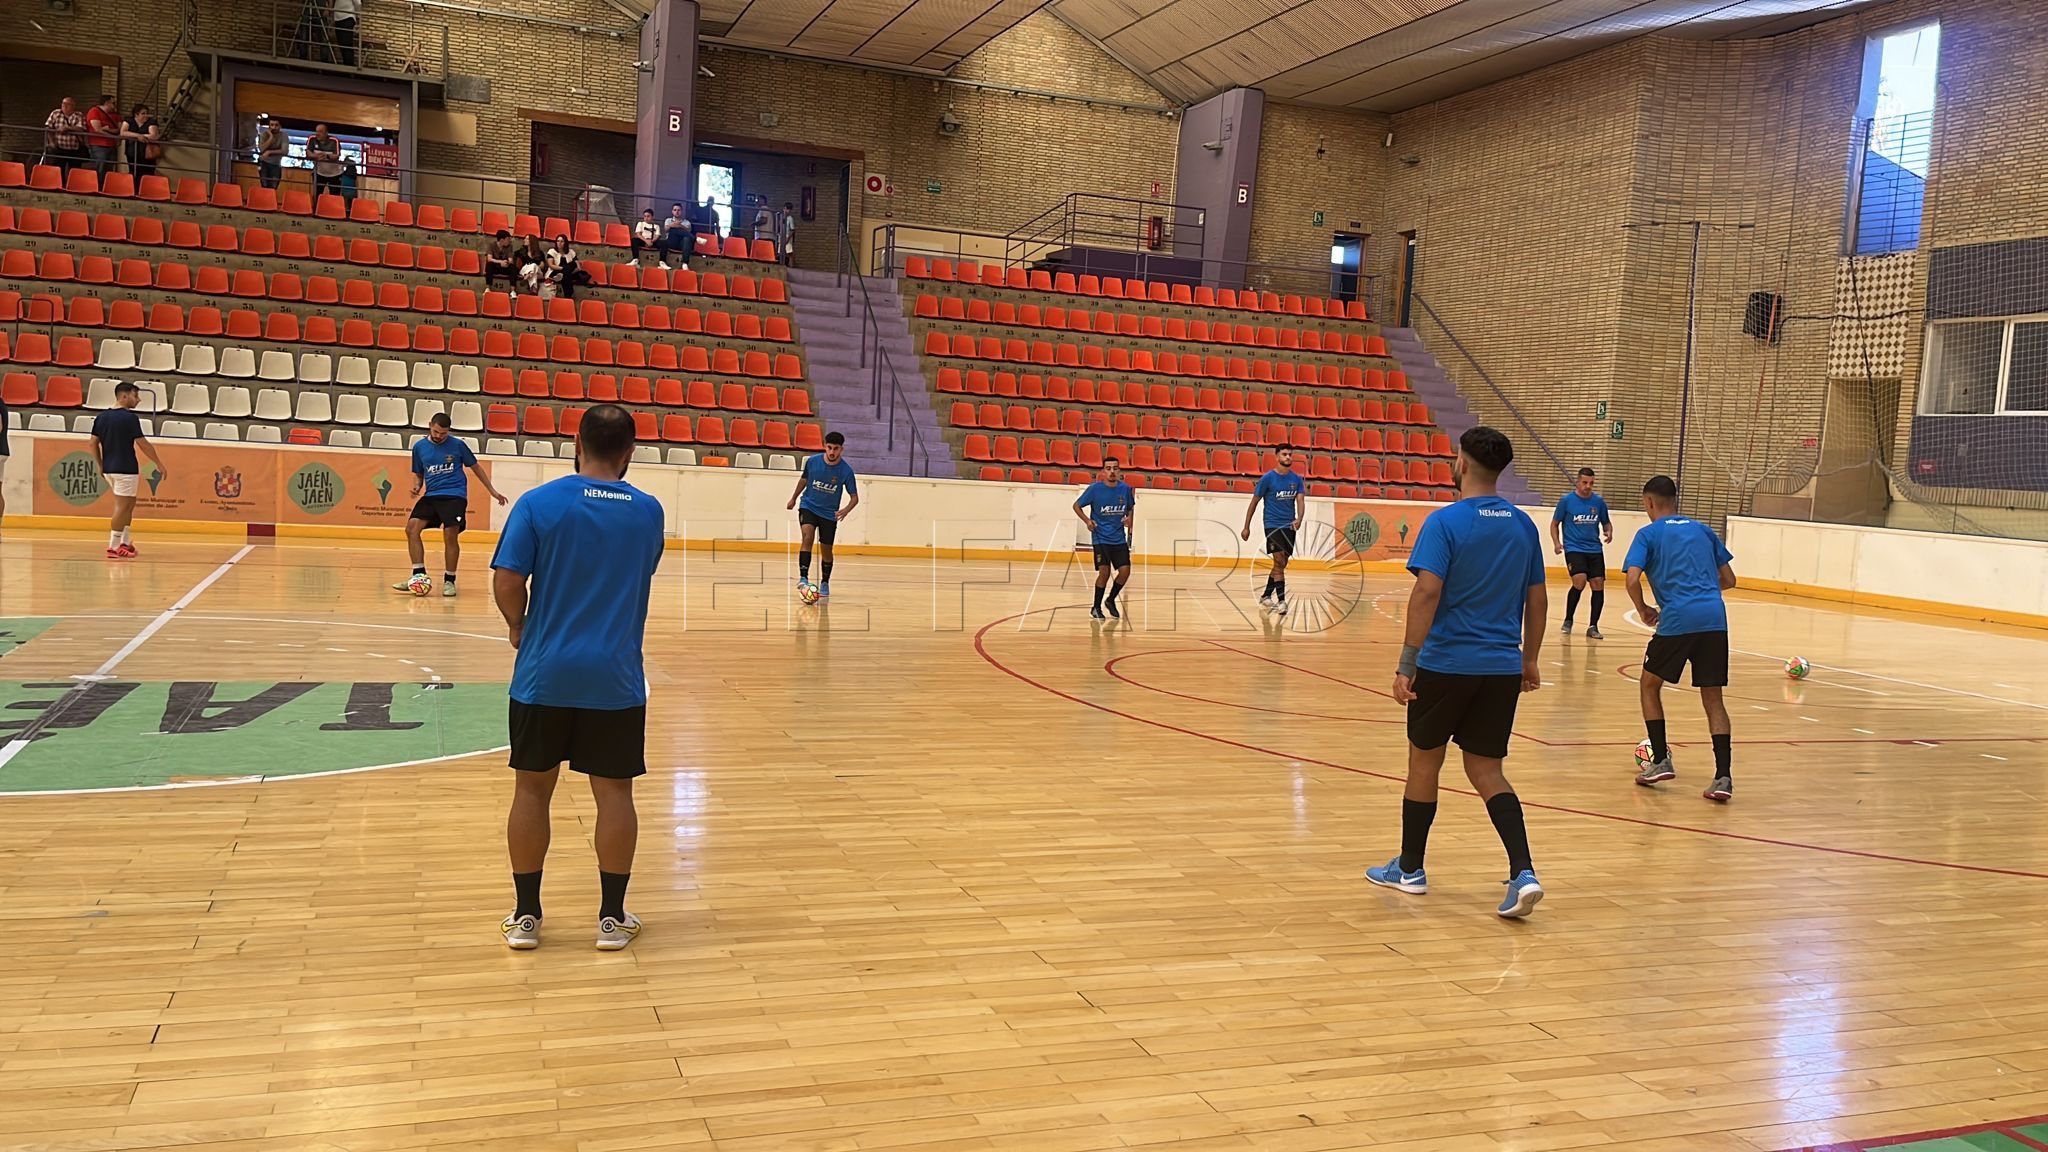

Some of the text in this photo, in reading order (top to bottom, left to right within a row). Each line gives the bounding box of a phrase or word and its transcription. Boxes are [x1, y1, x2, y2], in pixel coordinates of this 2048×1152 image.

[670, 114, 680, 132] B
[1238, 188, 1248, 203] B
[60, 460, 98, 480] JAÉN,
[298, 470, 332, 490] JAÉN,
